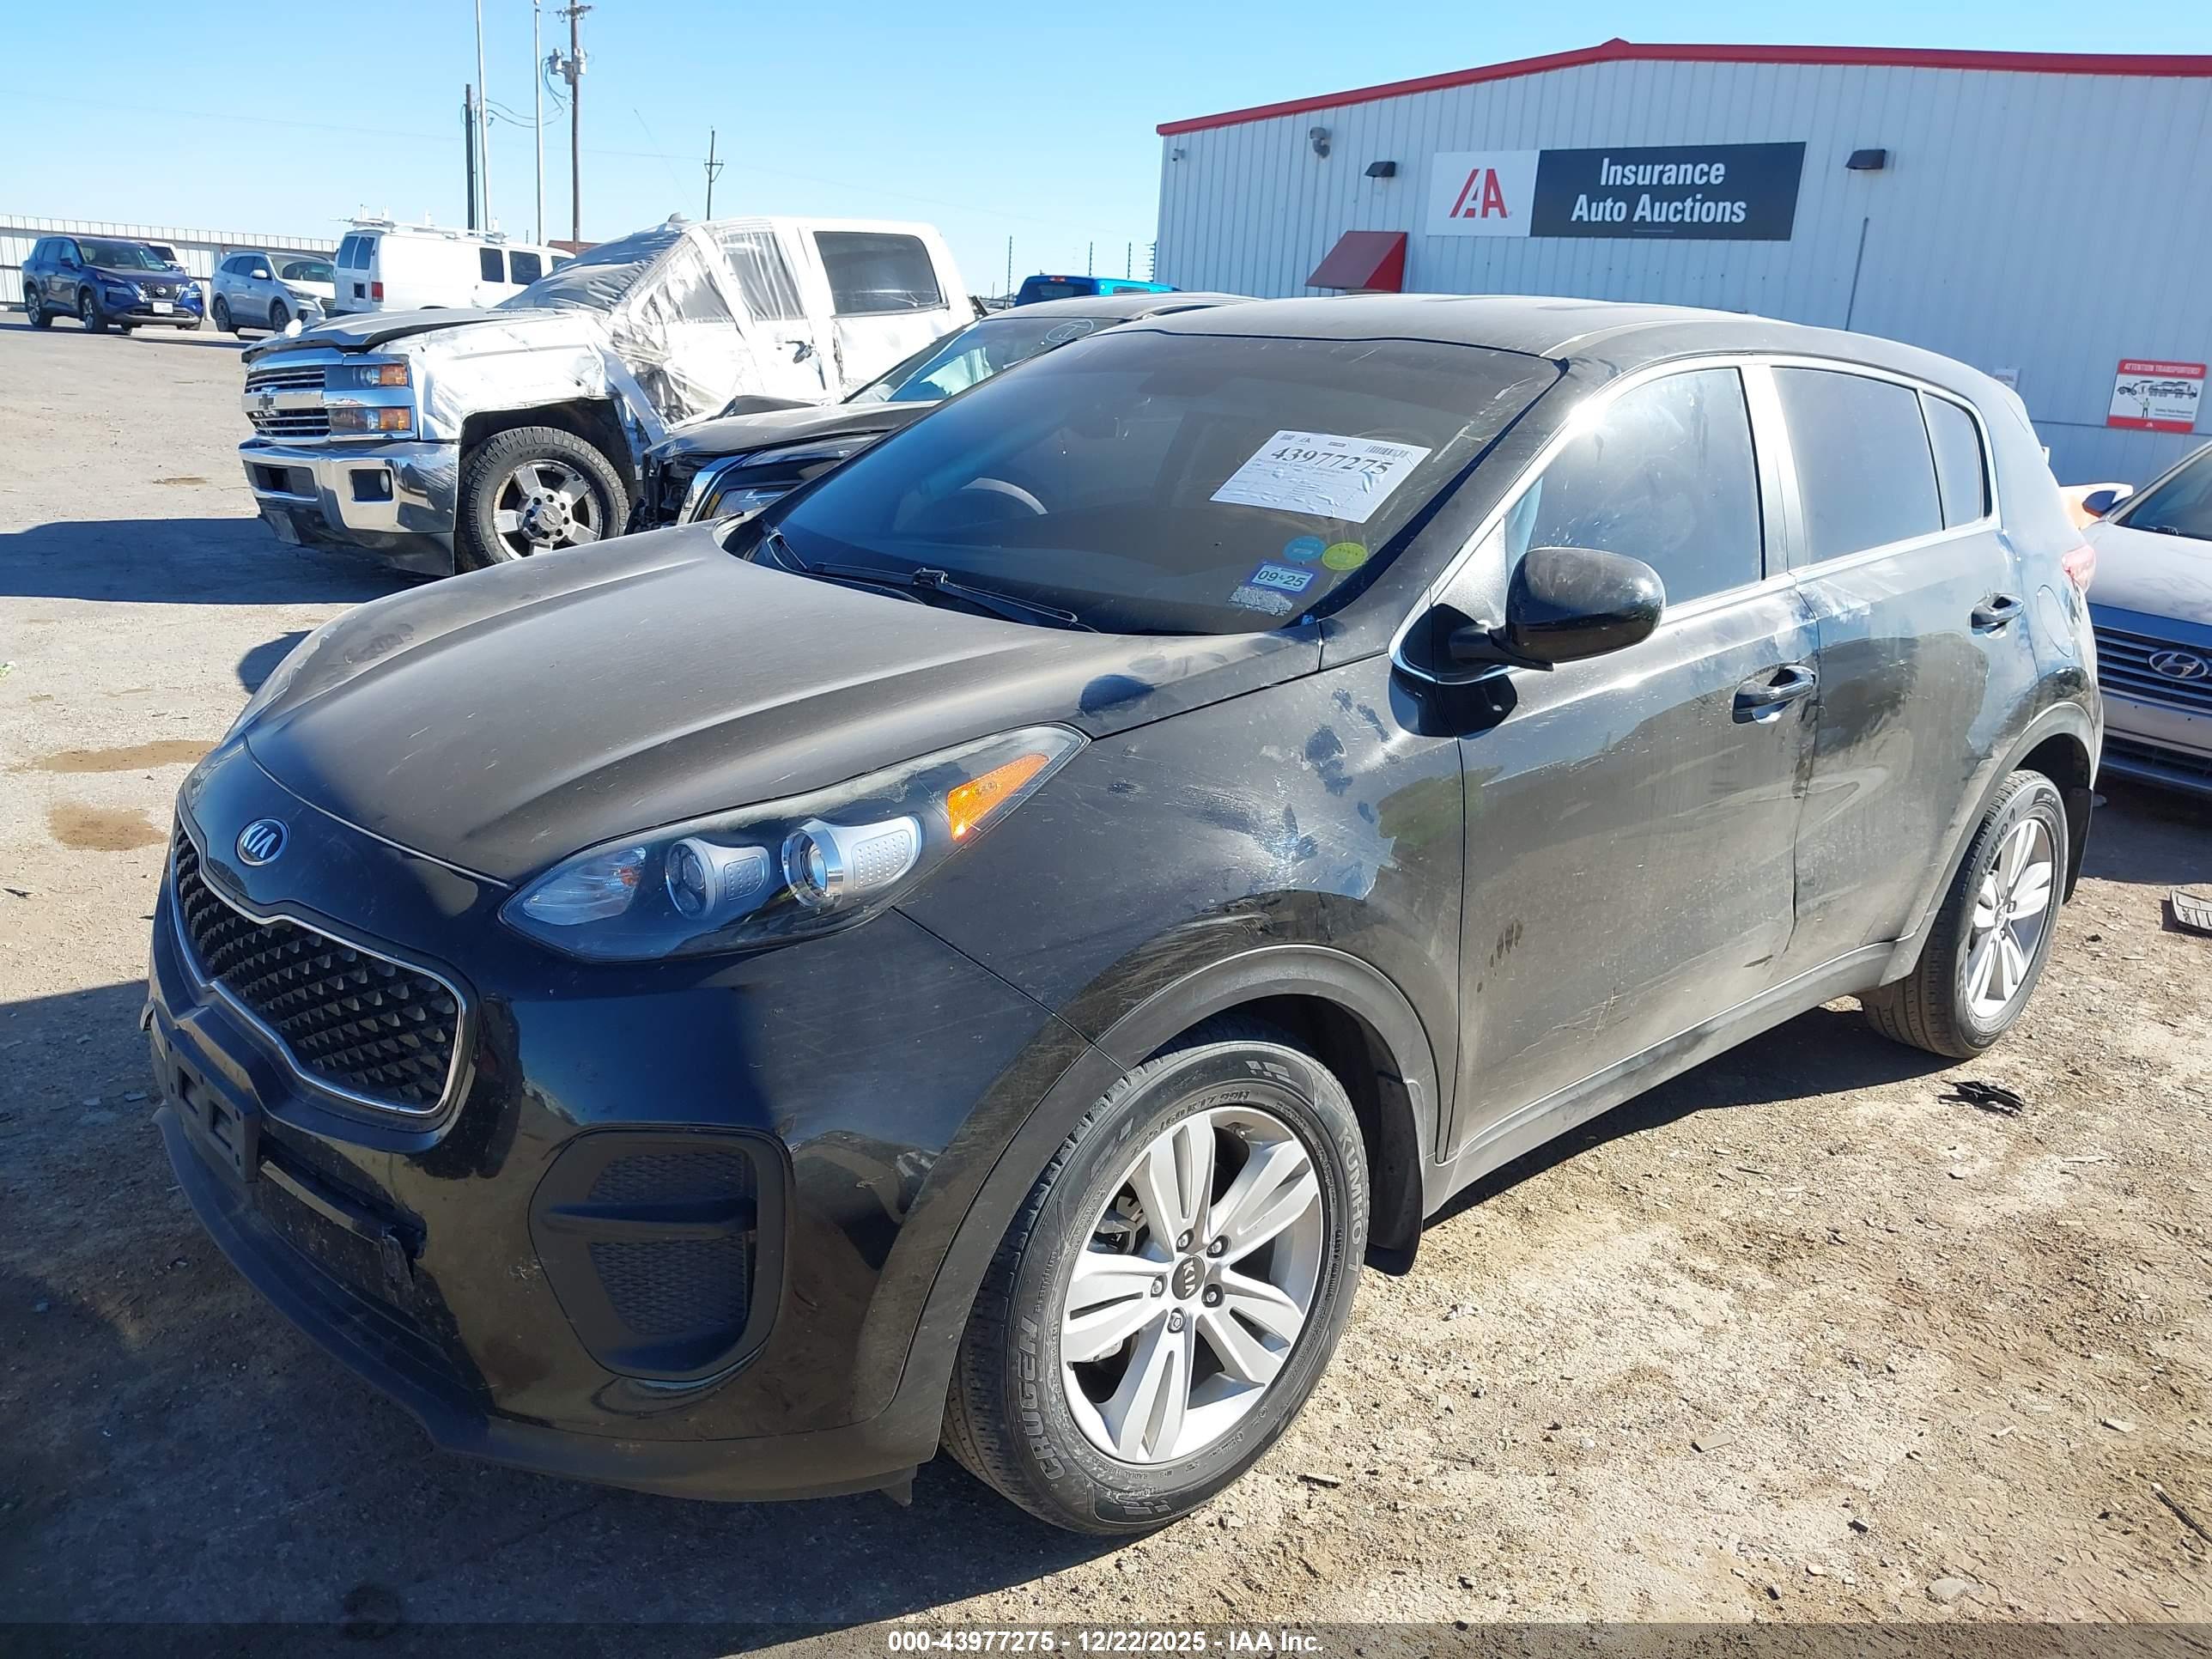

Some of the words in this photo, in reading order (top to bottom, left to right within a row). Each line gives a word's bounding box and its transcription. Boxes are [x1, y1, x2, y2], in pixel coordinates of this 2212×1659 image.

[1600, 157, 1726, 186] Insurance
[1570, 193, 1627, 222] Auto
[1632, 193, 1747, 223] Auctions
[1271, 447, 1395, 475] 43977275
[1257, 569, 1279, 582] 09
[1283, 574, 1306, 587] 25
[240, 822, 277, 859] KIA
[1338, 1126, 1363, 1245] KUMHO
[1182, 1259, 1196, 1298] KIA
[1018, 1316, 1066, 1480] CRUGEN
